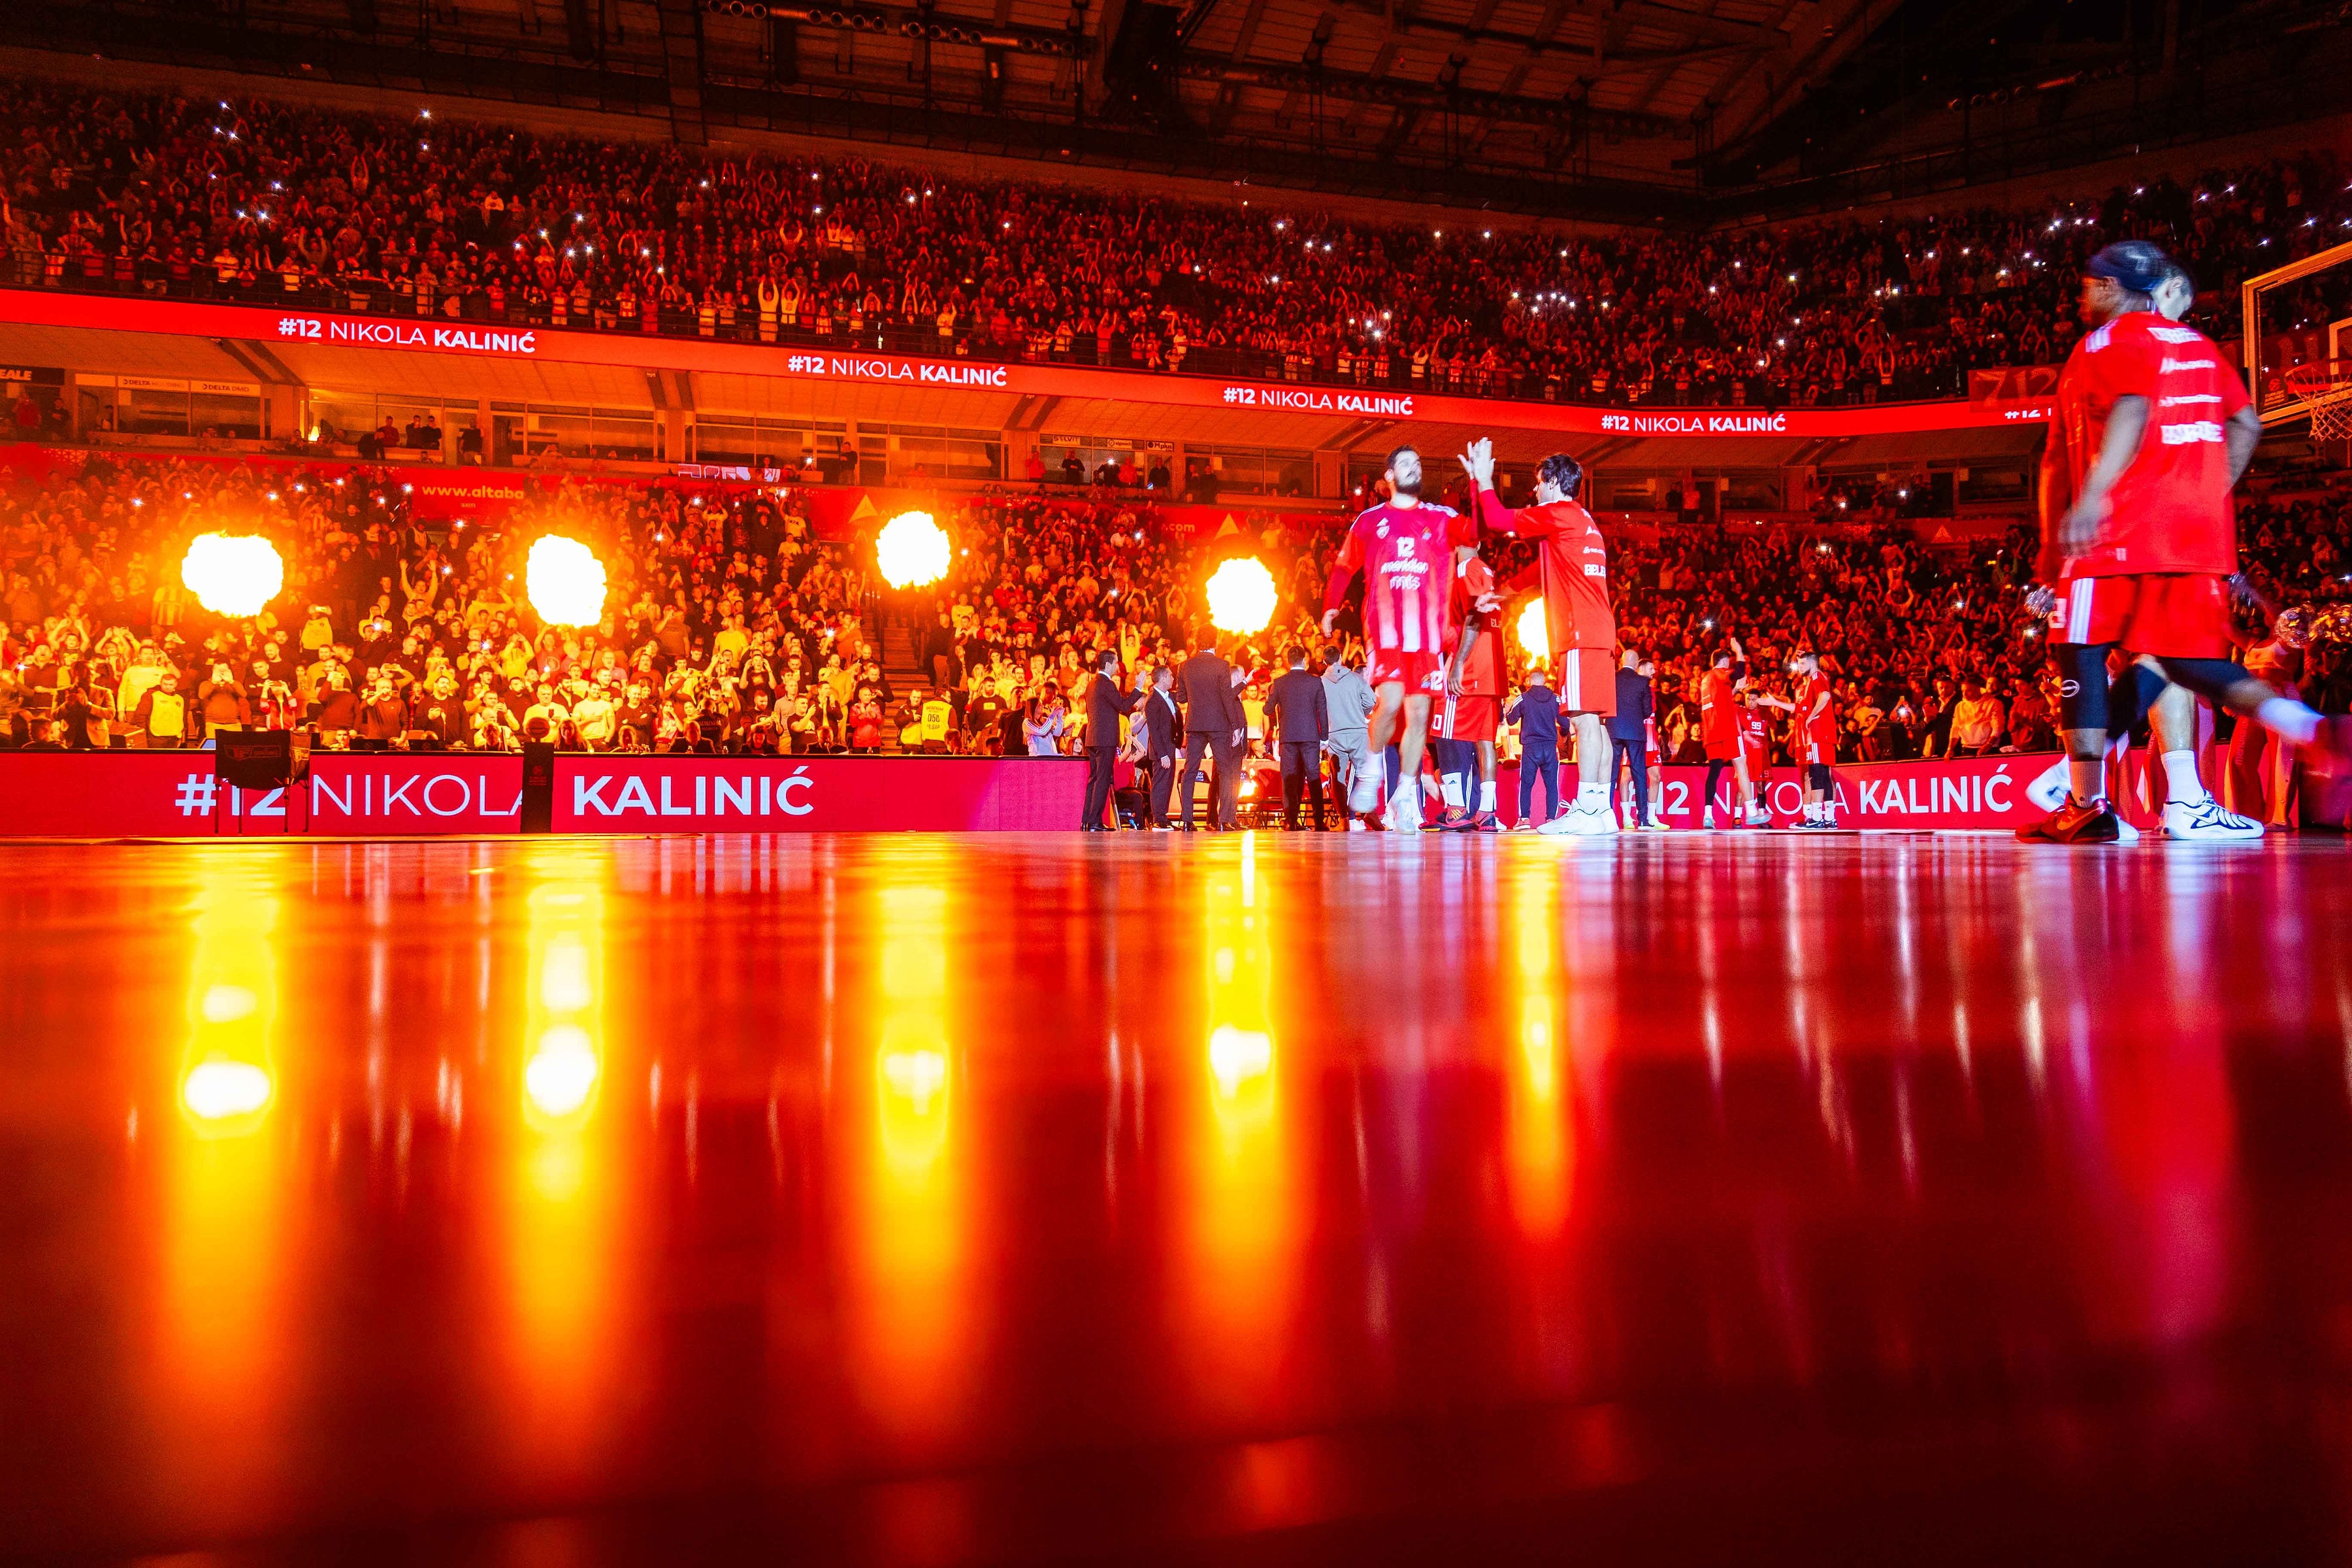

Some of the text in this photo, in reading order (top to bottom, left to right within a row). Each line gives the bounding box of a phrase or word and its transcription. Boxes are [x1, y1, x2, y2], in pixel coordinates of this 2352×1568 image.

[278, 318, 536, 353] #12 NIKOLA KALINIĆ
[788, 355, 1007, 386] #12 NIKOLA KALINIĆ
[1223, 387, 1413, 416] #12 NIKOLA KALINIĆ
[1601, 414, 1786, 432] #12 NIKOLA KALINIĆ
[1429, 670, 1443, 691] 12
[1751, 721, 1762, 730] 99
[574, 765, 814, 816] KALINIĆ
[1859, 763, 2013, 815] KALINIĆ
